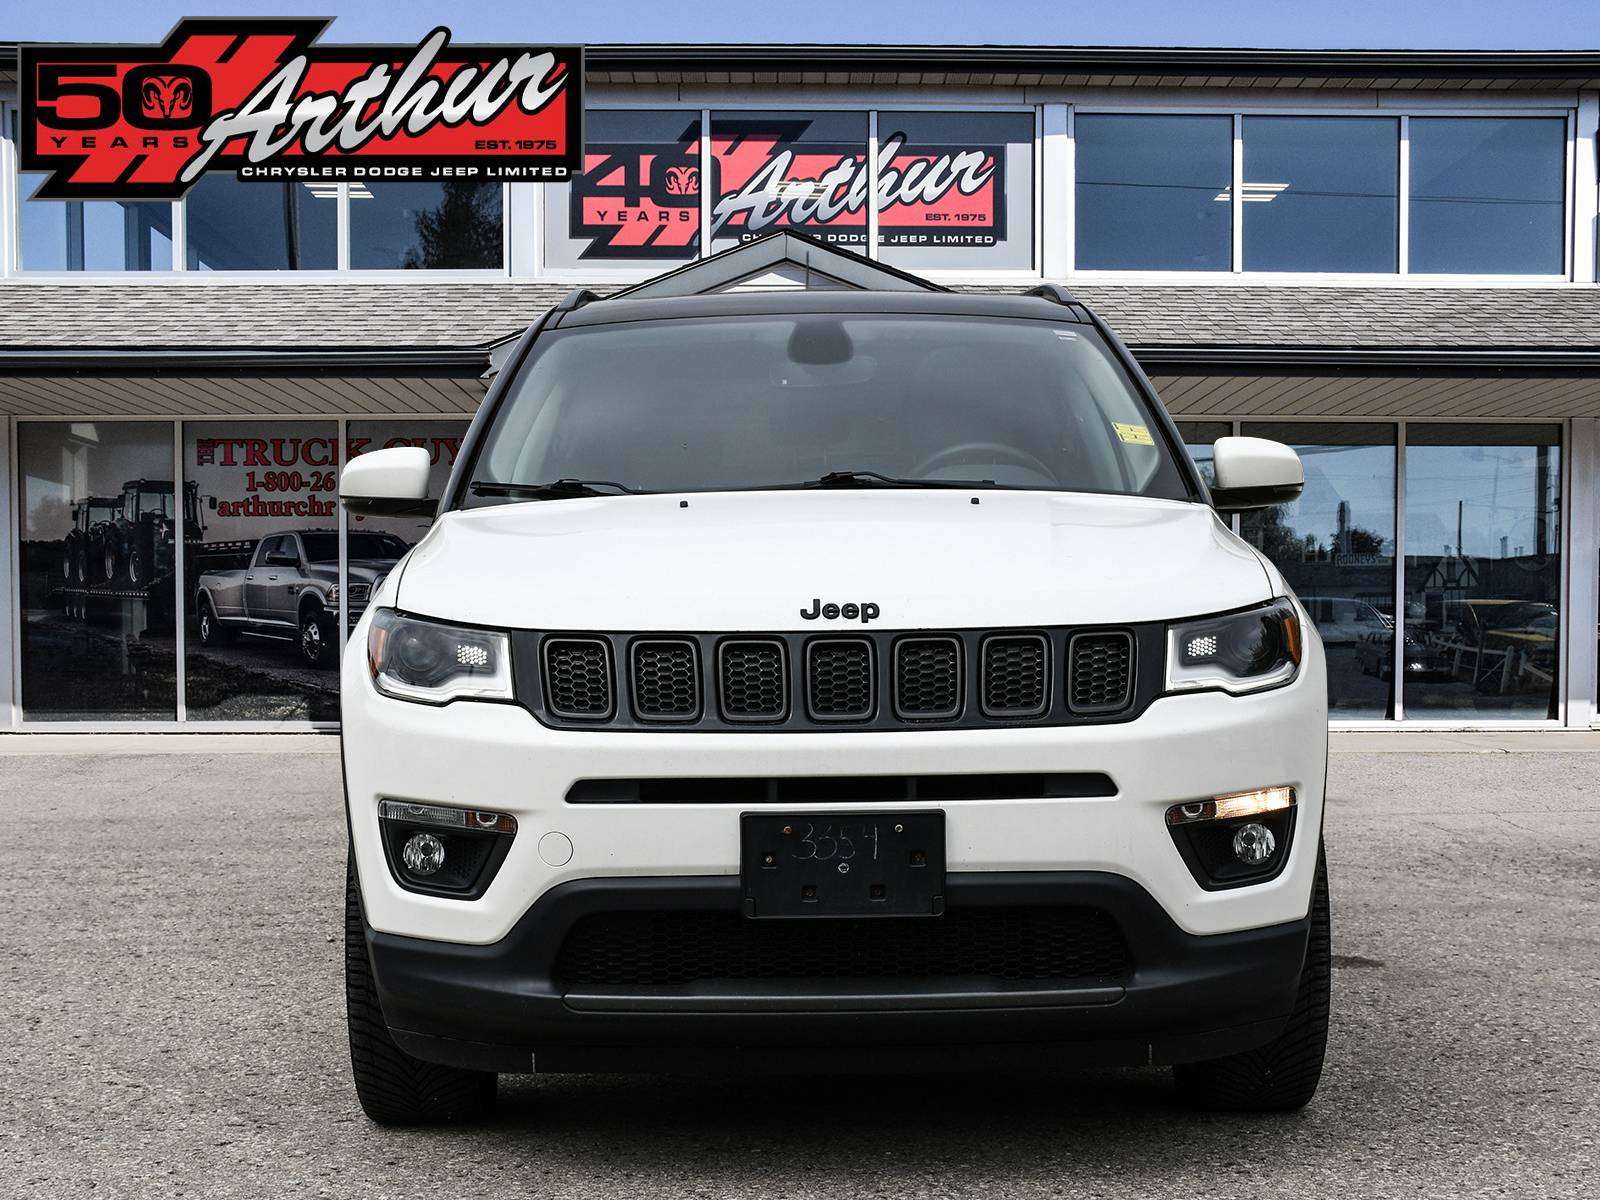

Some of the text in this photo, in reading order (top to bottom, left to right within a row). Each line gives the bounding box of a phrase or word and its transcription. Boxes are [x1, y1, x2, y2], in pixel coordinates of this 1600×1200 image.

[583, 154, 721, 208] 40
[694, 133, 995, 246] Arthur
[597, 210, 690, 222] YEARS
[925, 212, 986, 221] EST. 1975
[890, 235, 927, 243] JEEP
[933, 235, 993, 244] LIMITED
[800, 598, 880, 623] Jeep
